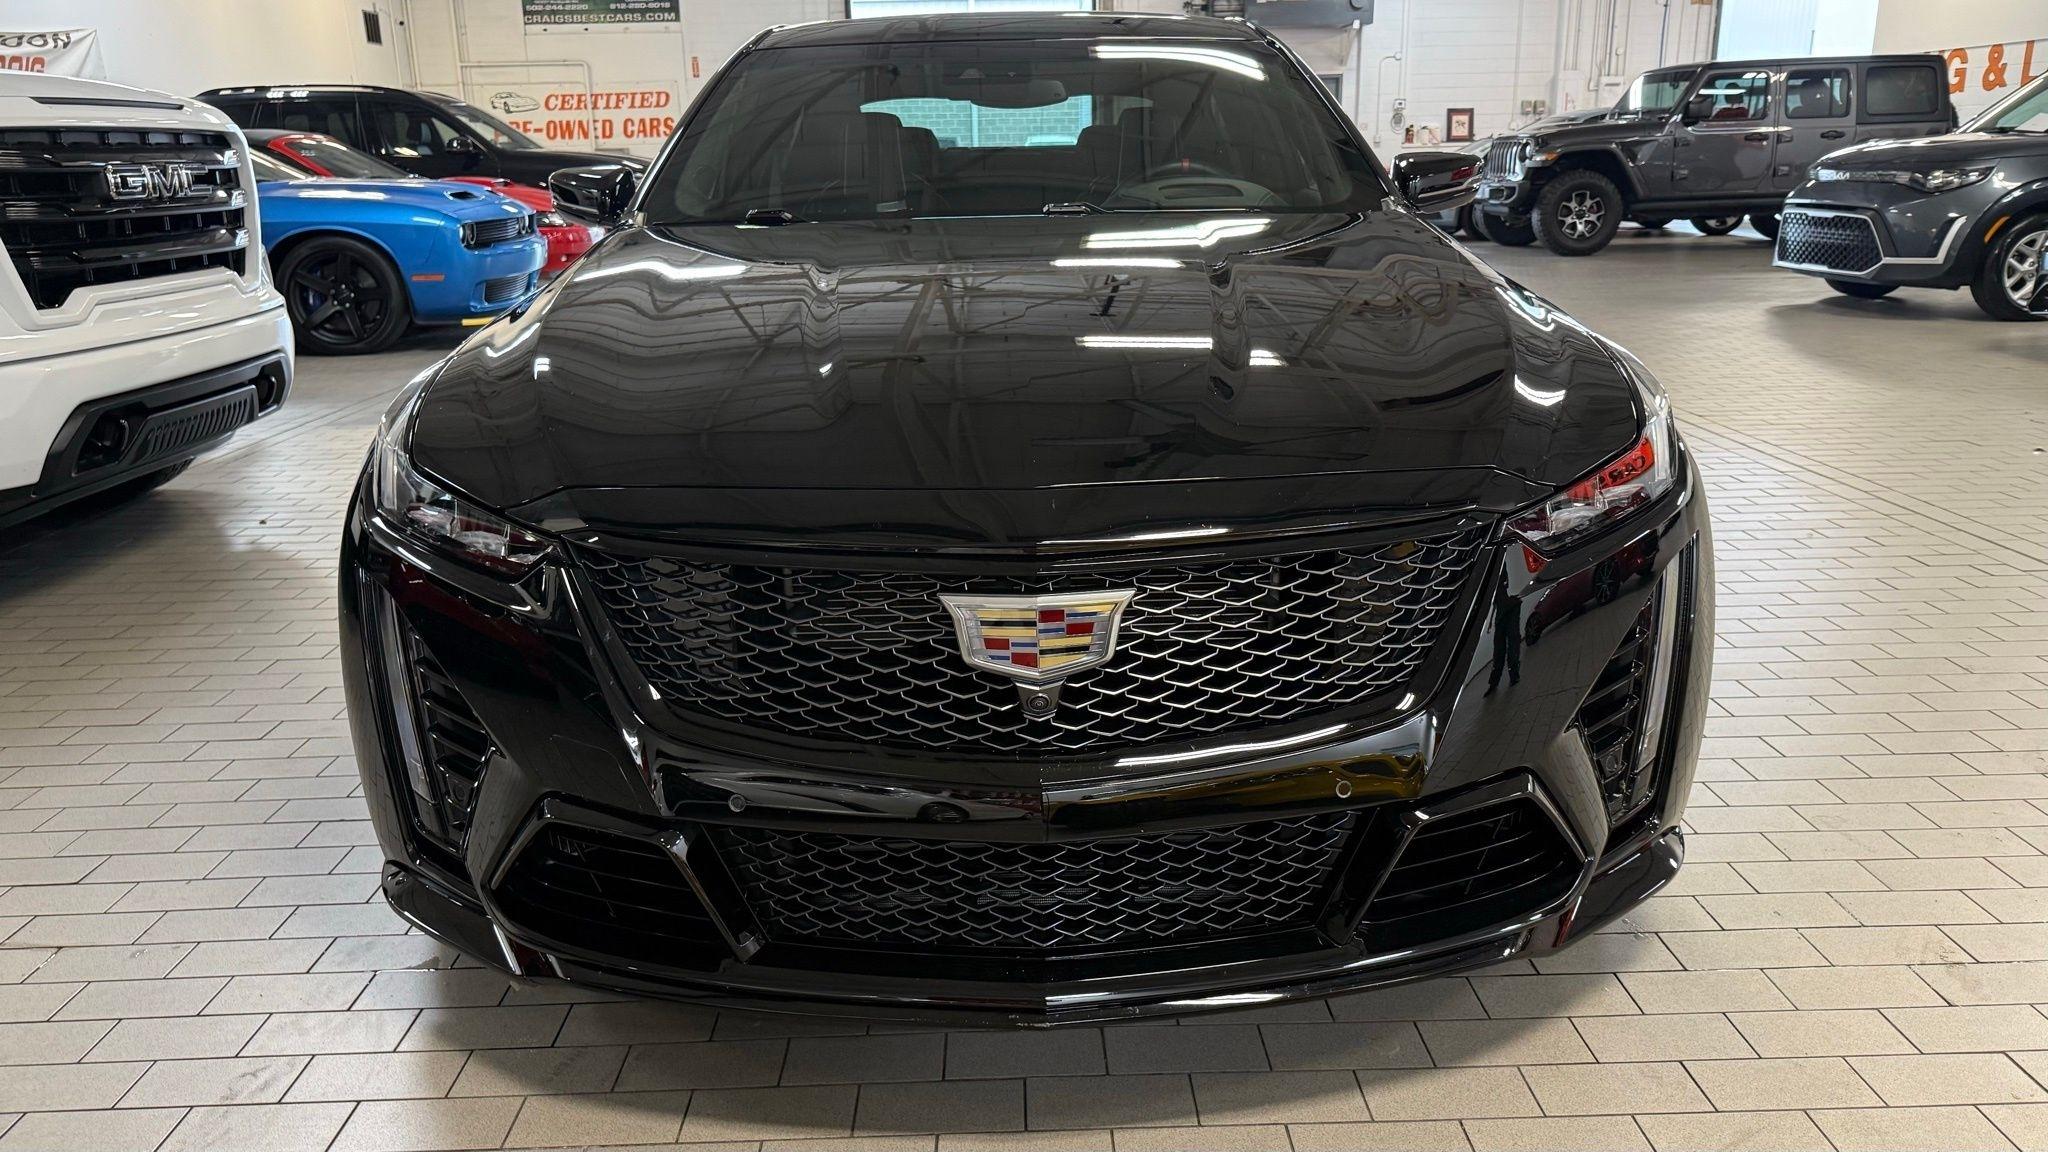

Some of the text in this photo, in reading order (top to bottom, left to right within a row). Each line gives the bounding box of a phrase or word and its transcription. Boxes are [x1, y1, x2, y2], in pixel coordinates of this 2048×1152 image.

[524, 12, 676, 23] CRAIGSBESTCARS.COM
[1982, 44, 2007, 91] &
[544, 91, 671, 111] CERTIFIED
[493, 117, 676, 143] E-OWNED CARS
[105, 165, 214, 200] GMC
